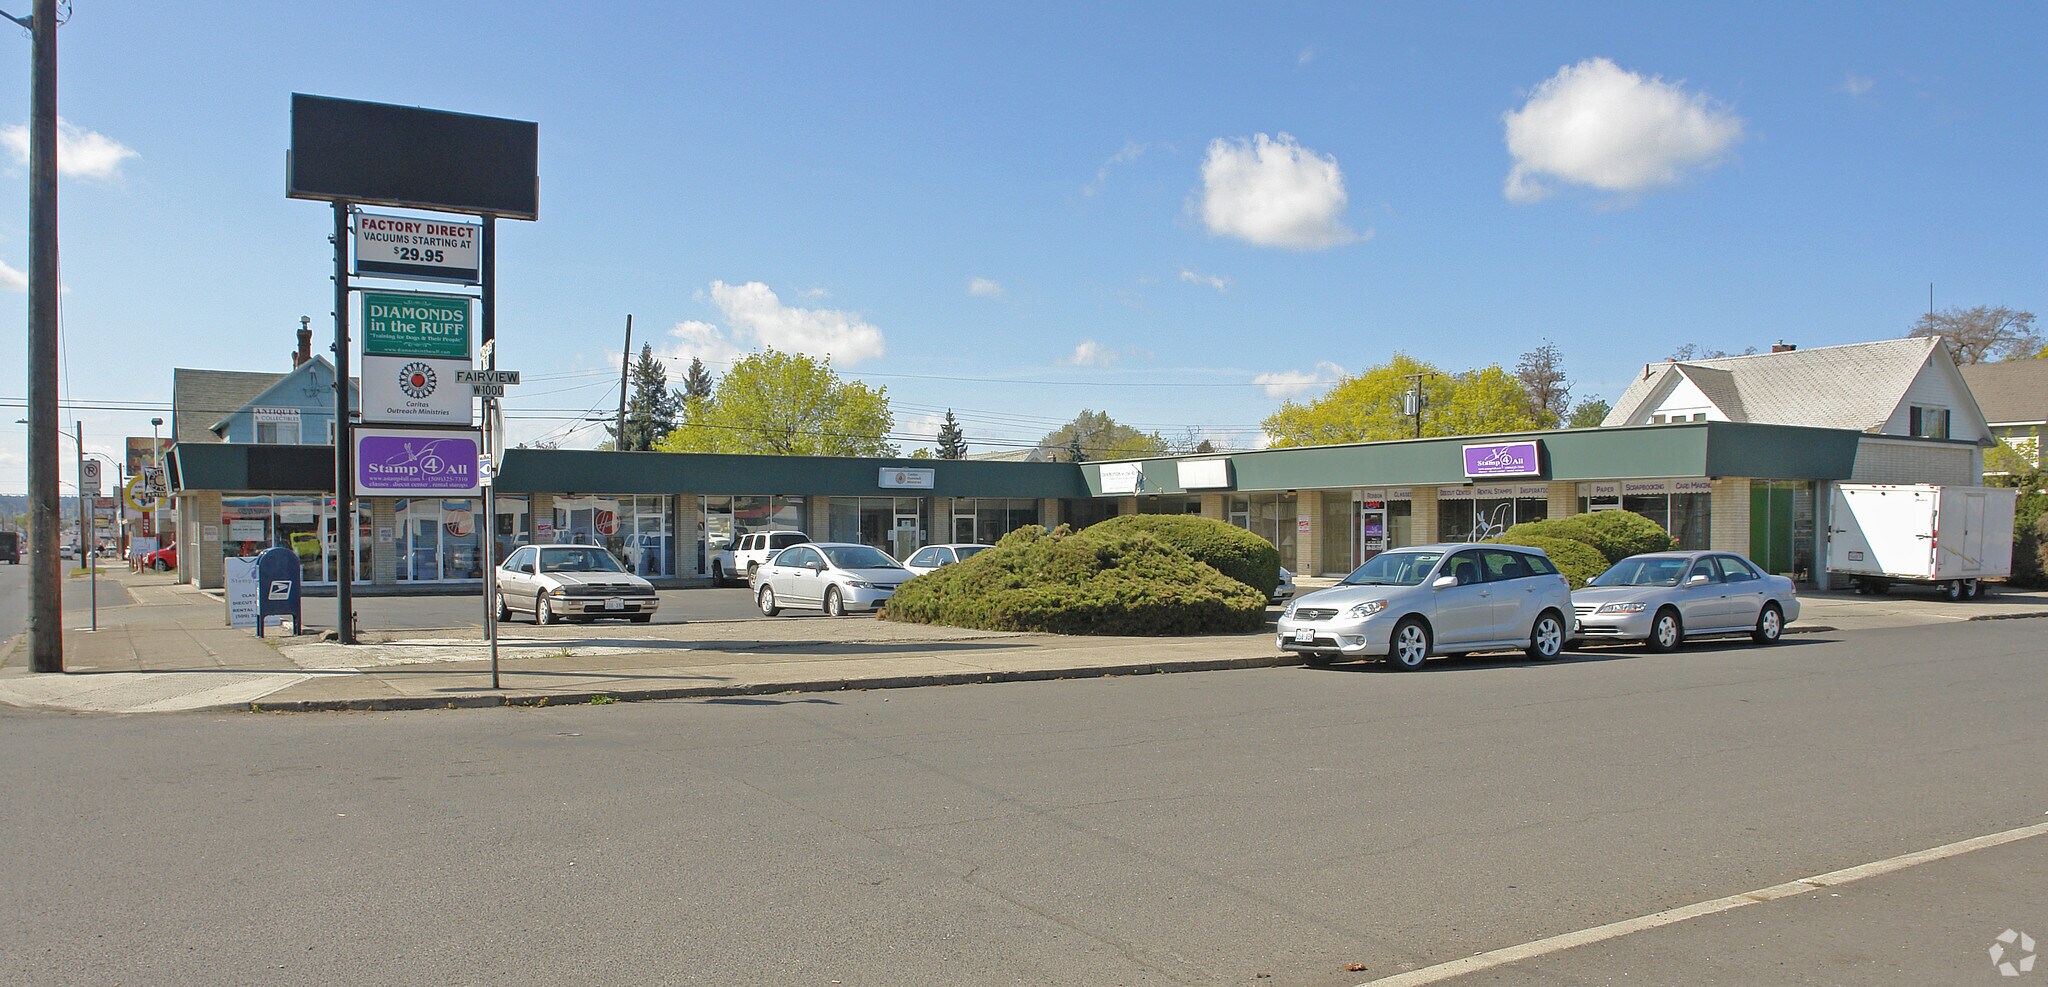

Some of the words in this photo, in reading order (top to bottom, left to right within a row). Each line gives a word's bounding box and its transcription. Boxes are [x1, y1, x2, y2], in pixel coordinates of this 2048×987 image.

[361, 218, 422, 234] FACTORY
[426, 224, 474, 238] DIRECT
[363, 231, 410, 244] VACUUMS
[412, 235, 458, 248] STARTING
[460, 240, 472, 249] AT
[393, 246, 444, 263] $29.95
[370, 304, 464, 323] DIAMONDS
[371, 318, 386, 332] in
[391, 321, 417, 334] the
[421, 321, 465, 336] RUFF
[456, 371, 518, 383] FAIRVIEW
[386, 407, 417, 415] Outreach
[418, 407, 450, 416] Ministries
[405, 400, 430, 408] Caritas
[368, 463, 419, 476] Stamp
[424, 457, 438, 472] 4
[445, 464, 468, 475] All
[1625, 483, 1665, 491] SCRAPBOOKING
[1676, 482, 1690, 490] CARD
